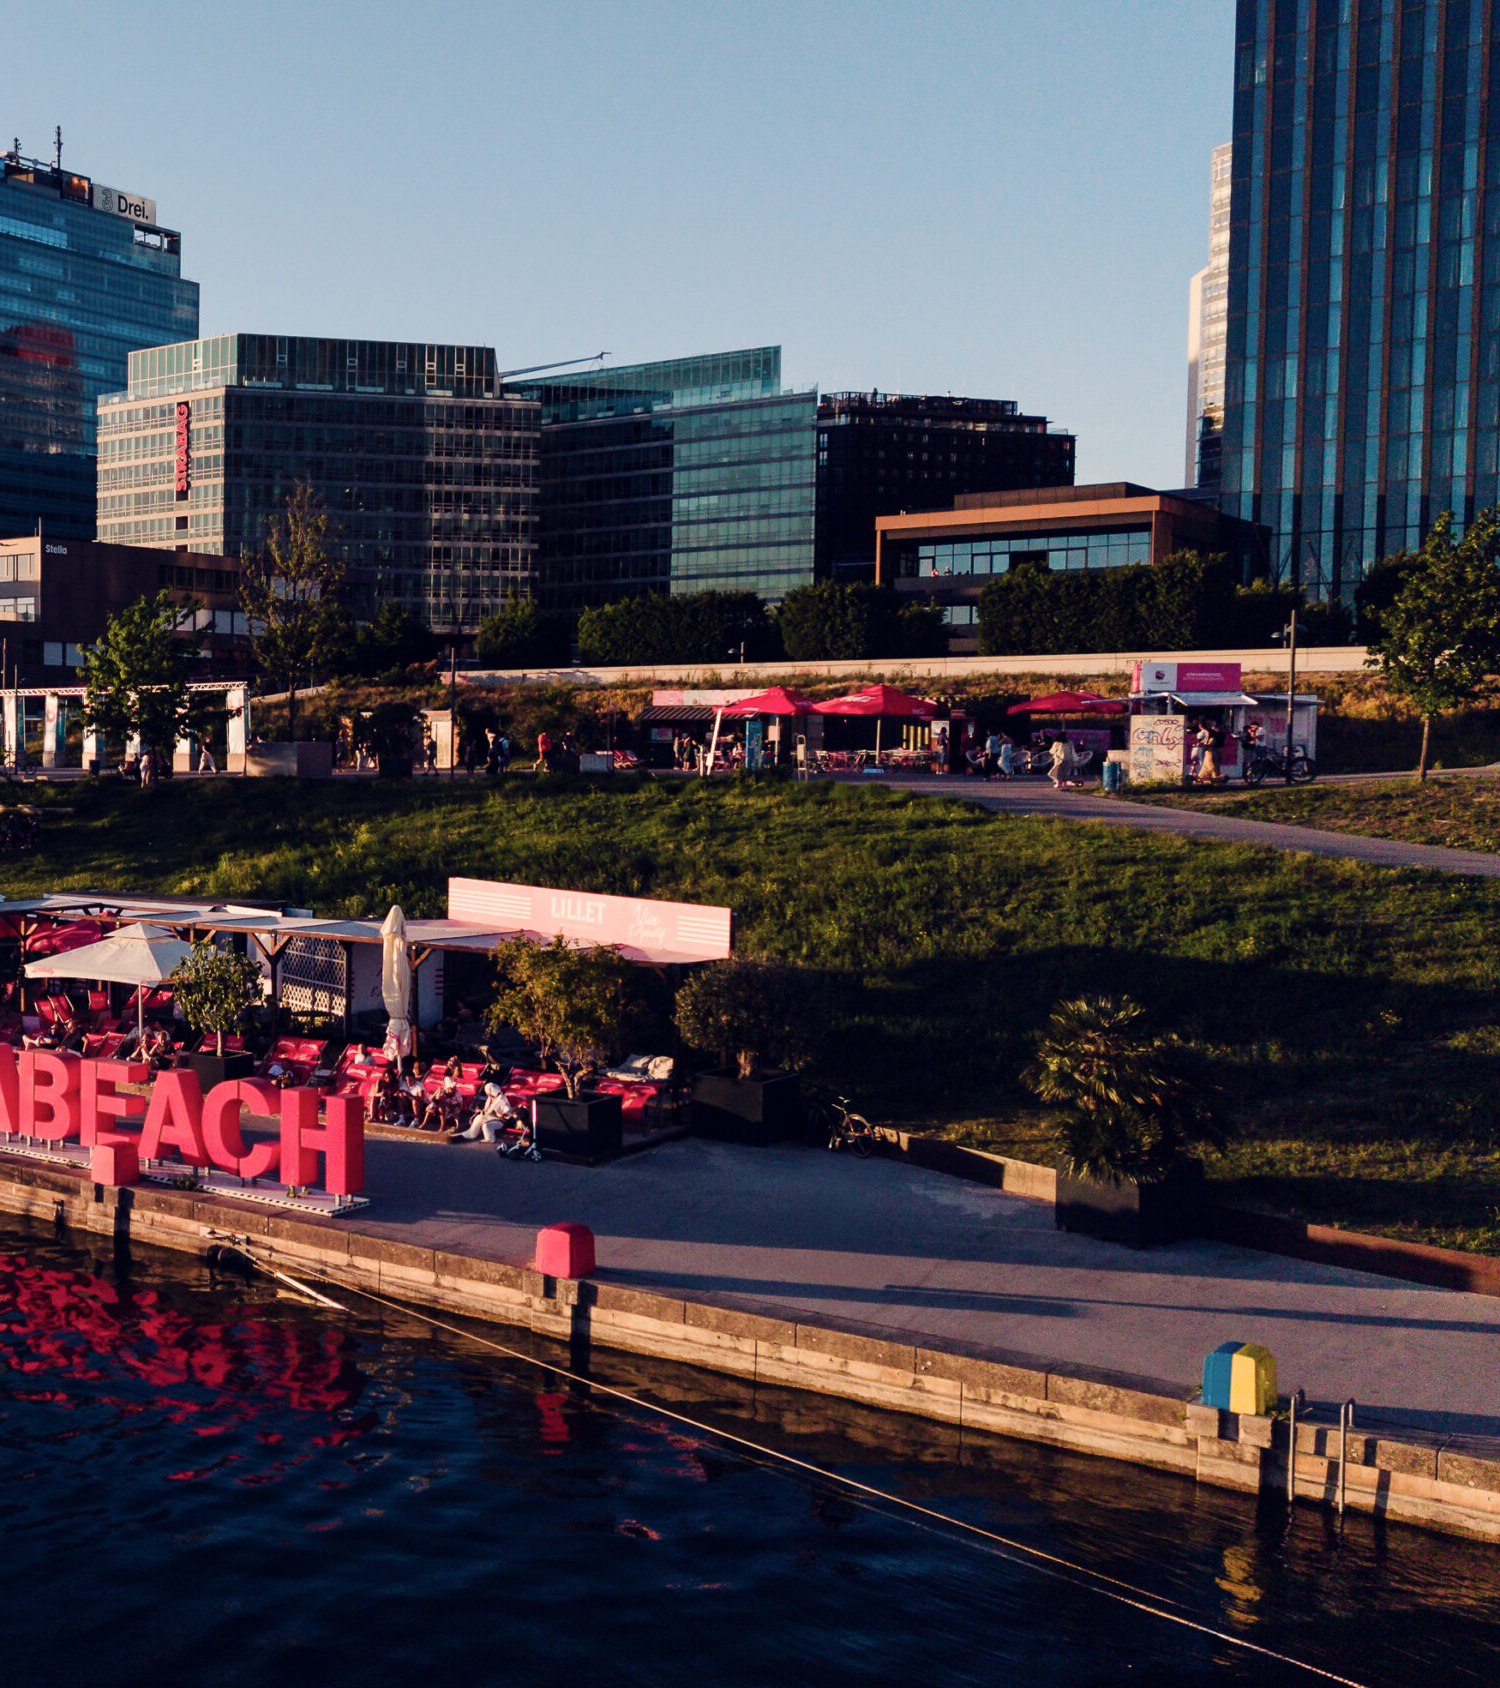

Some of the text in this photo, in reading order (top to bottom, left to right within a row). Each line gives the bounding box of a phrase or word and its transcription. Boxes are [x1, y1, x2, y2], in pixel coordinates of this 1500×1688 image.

[117, 194, 149, 220] Drei.
[175, 404, 189, 491] STRABAG
[551, 896, 607, 924] LILLET
